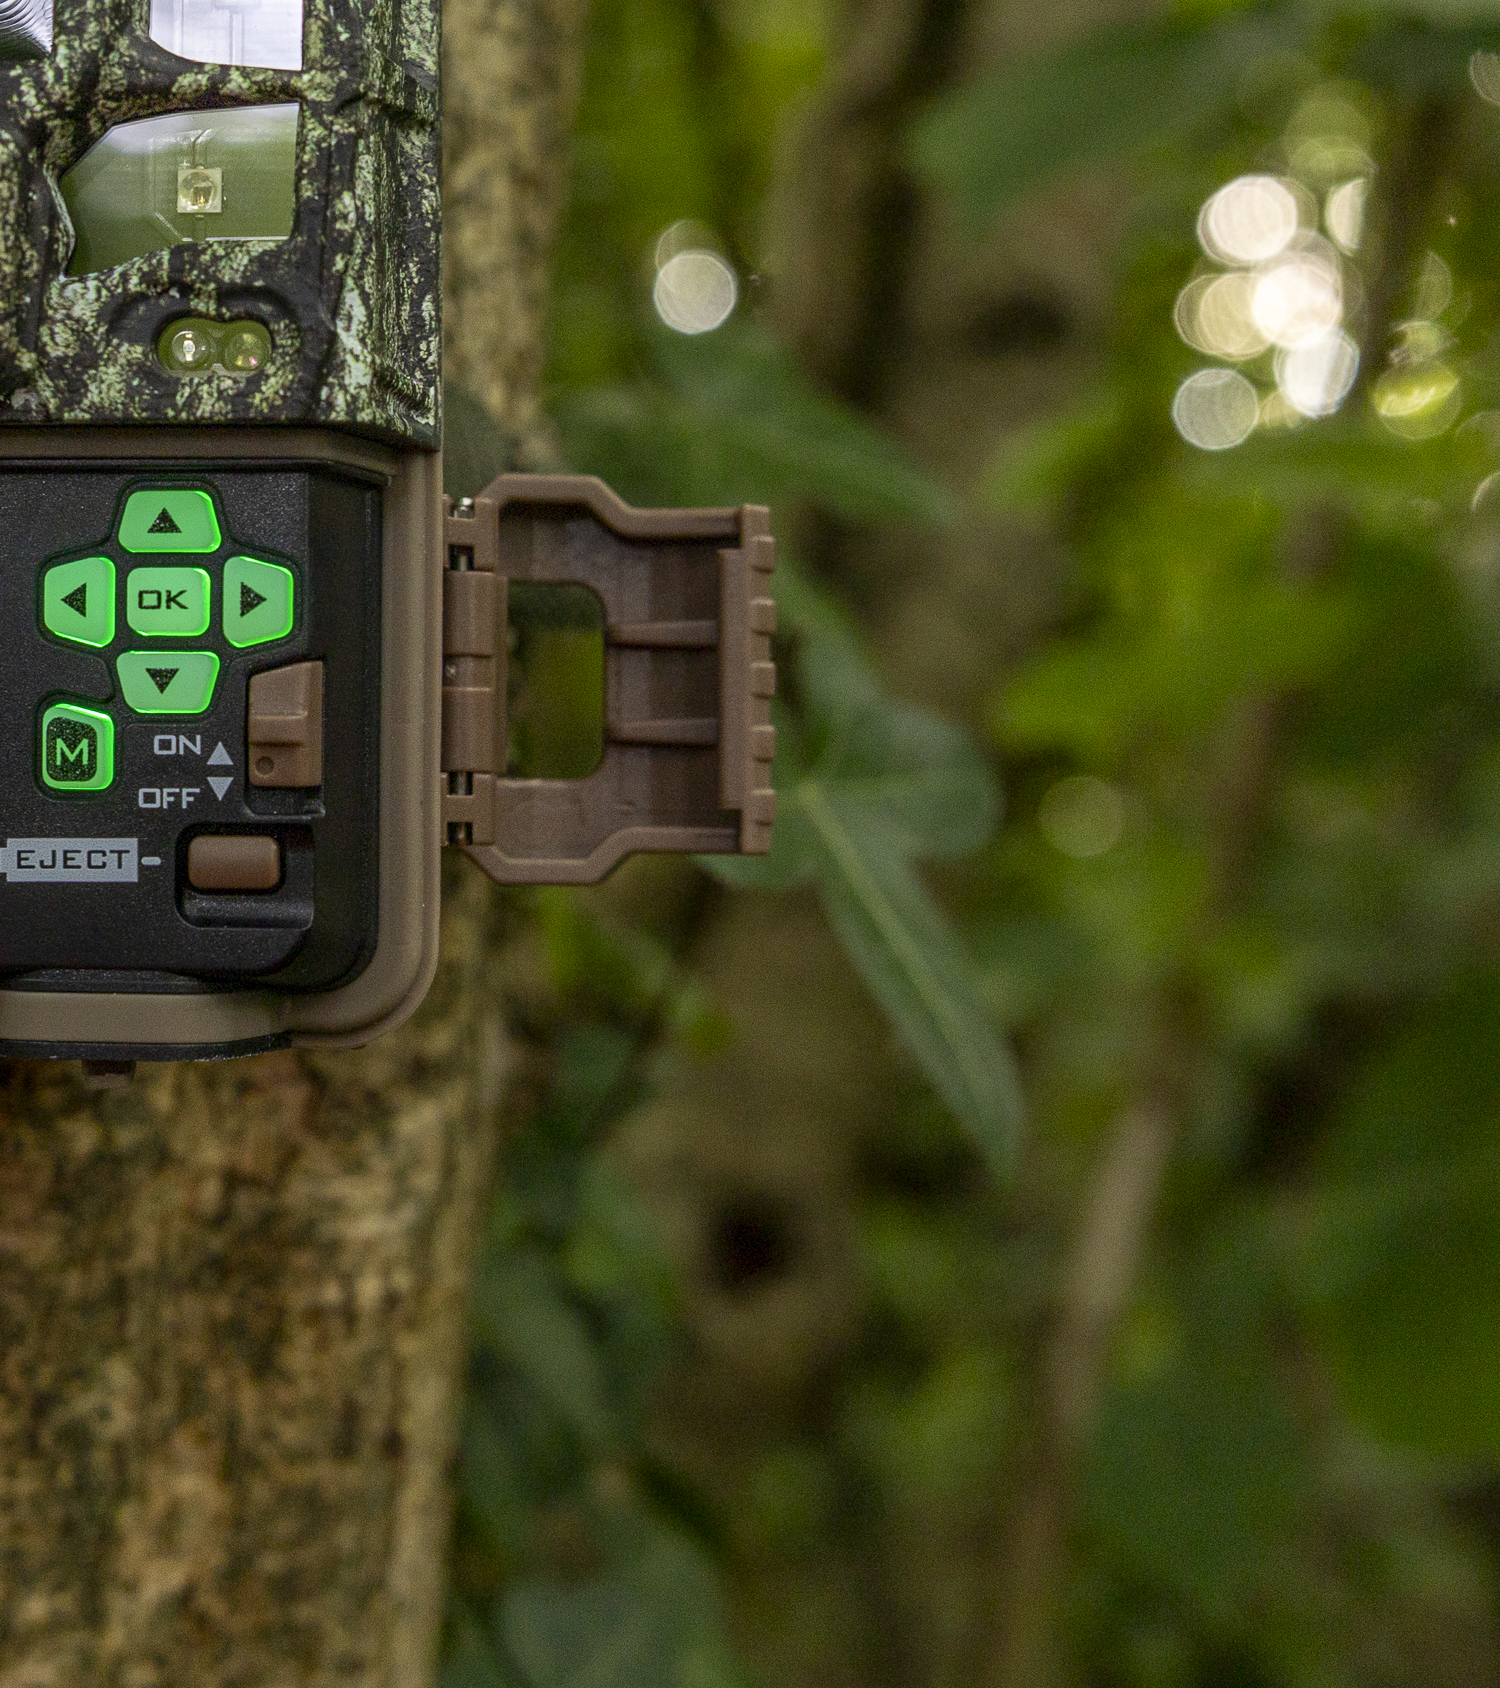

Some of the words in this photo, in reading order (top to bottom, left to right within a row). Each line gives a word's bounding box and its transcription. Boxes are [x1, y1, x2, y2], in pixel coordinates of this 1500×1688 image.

[138, 589, 189, 611] OK
[55, 739, 89, 766] M
[153, 735, 202, 756] ON
[138, 788, 201, 809] OFF
[16, 849, 131, 871] EJECT
